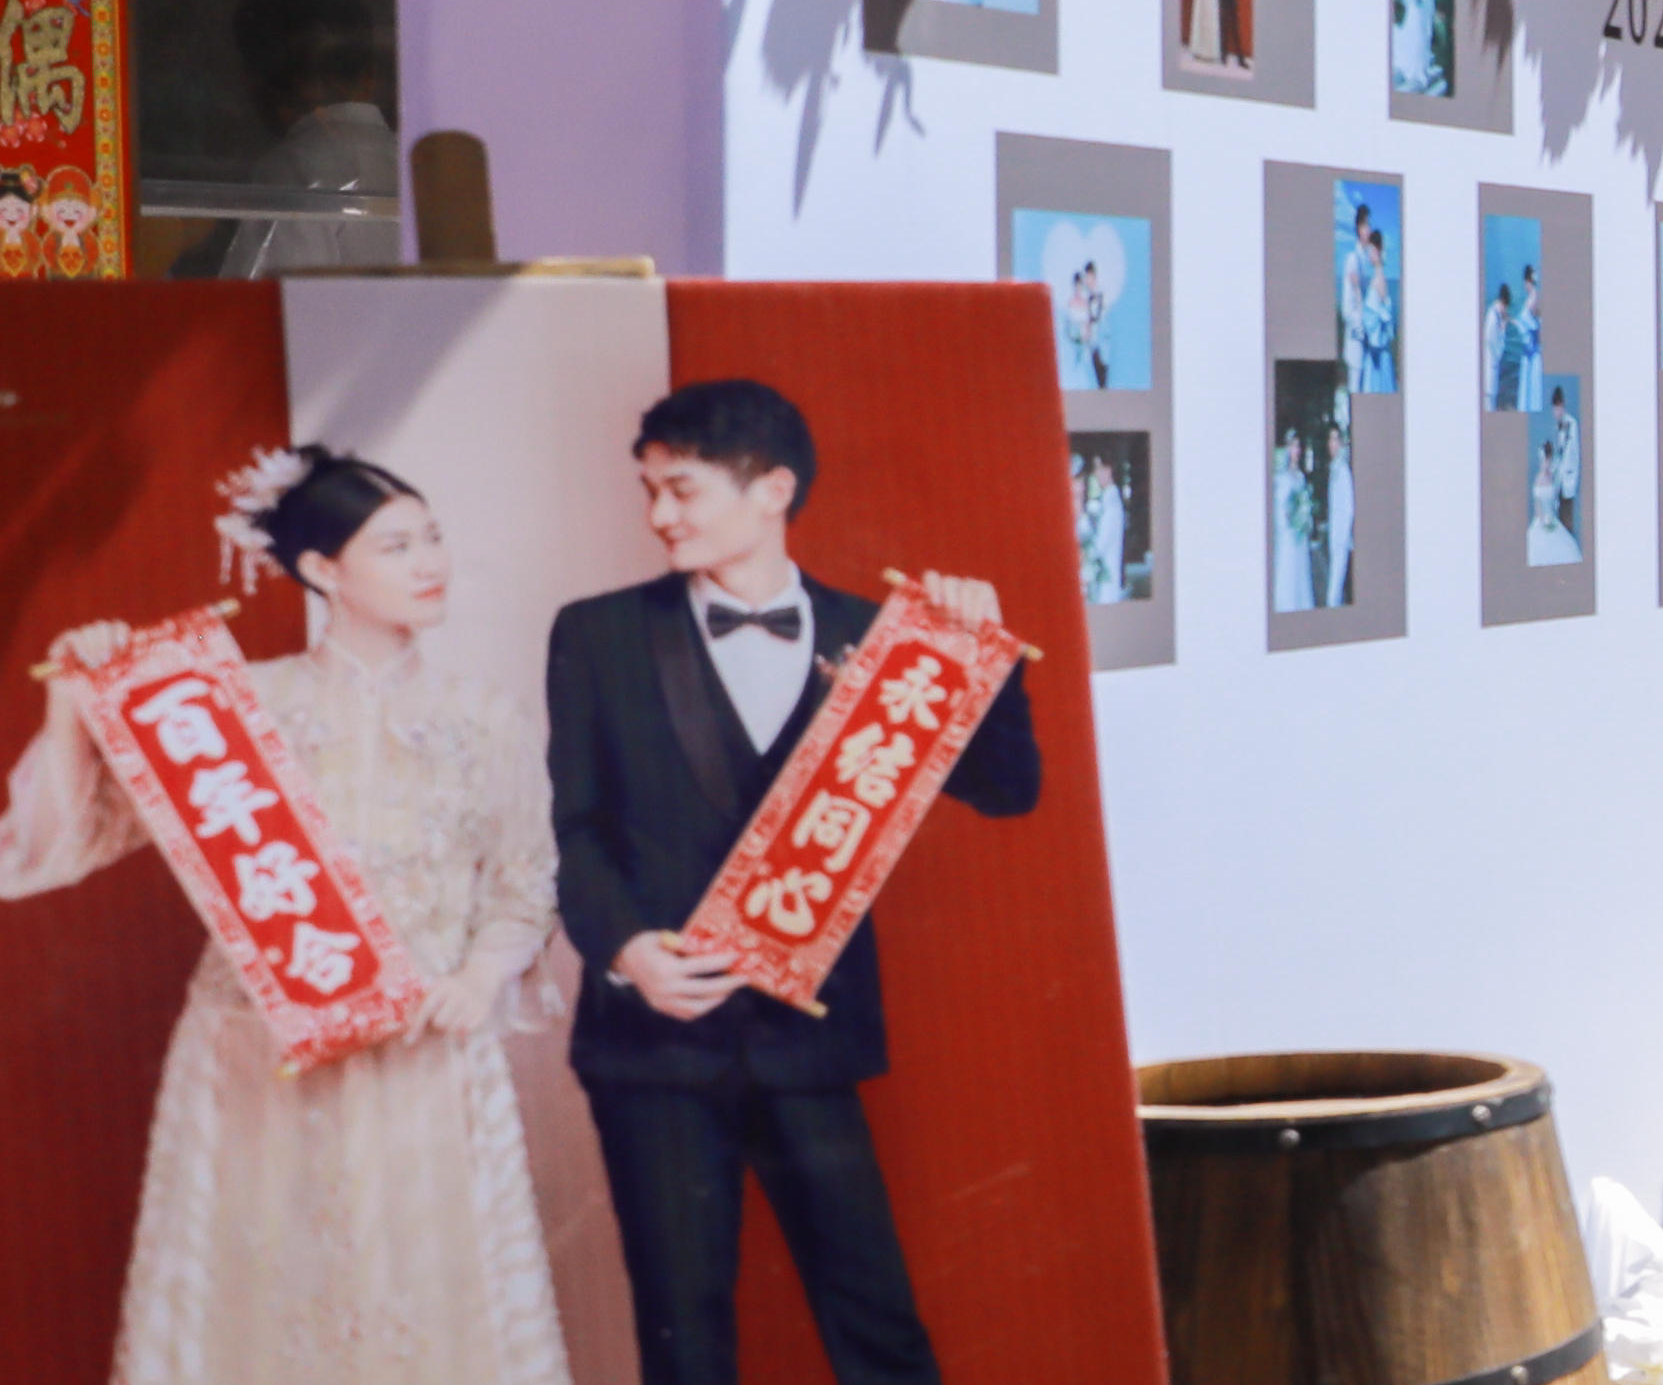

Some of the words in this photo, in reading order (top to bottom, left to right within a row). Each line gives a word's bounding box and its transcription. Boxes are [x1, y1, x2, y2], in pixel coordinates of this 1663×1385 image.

[131, 677, 361, 996] 百年好合
[743, 654, 948, 937] 永结同心
